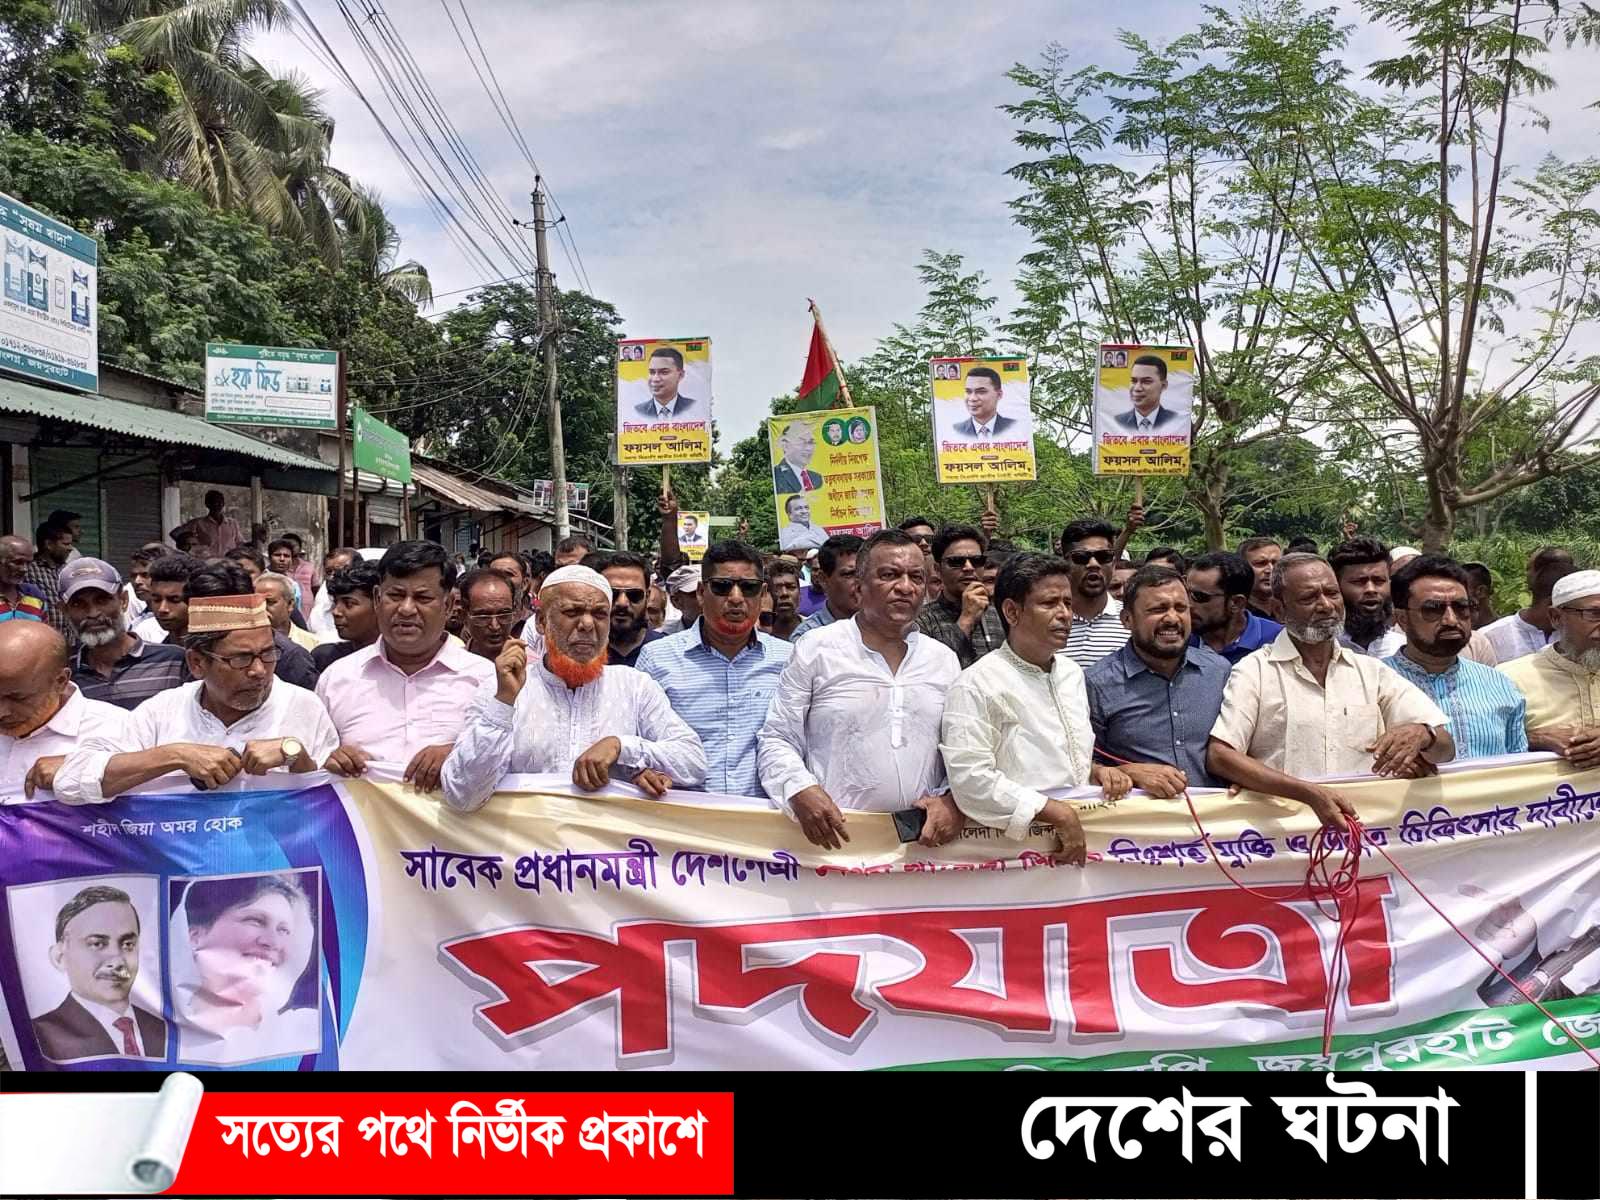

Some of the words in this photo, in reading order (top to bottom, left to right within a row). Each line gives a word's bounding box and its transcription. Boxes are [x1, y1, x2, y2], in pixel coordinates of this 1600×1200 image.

[623, 422, 648, 434] জিতবে
[650, 422, 670, 433] এবার
[671, 420, 705, 433] বাংলাদেশ
[1103, 432, 1128, 446] জিতবে
[1130, 435, 1149, 446] এবার
[1152, 434, 1187, 446] বাংলাদেশ
[942, 440, 968, 453] জিতবে
[970, 441, 990, 453] এবার
[992, 440, 1028, 453] বাংলাদেশ
[944, 462, 984, 473] ফয়সল
[1103, 455, 1142, 467] ফয়সল
[159, 820, 198, 836] অমর
[203, 815, 245, 833] হোক
[400, 845, 502, 890] সাবেক
[514, 838, 660, 894] প্রধানমন্ত্রী
[442, 877, 1398, 1060] পদযাত্রা
